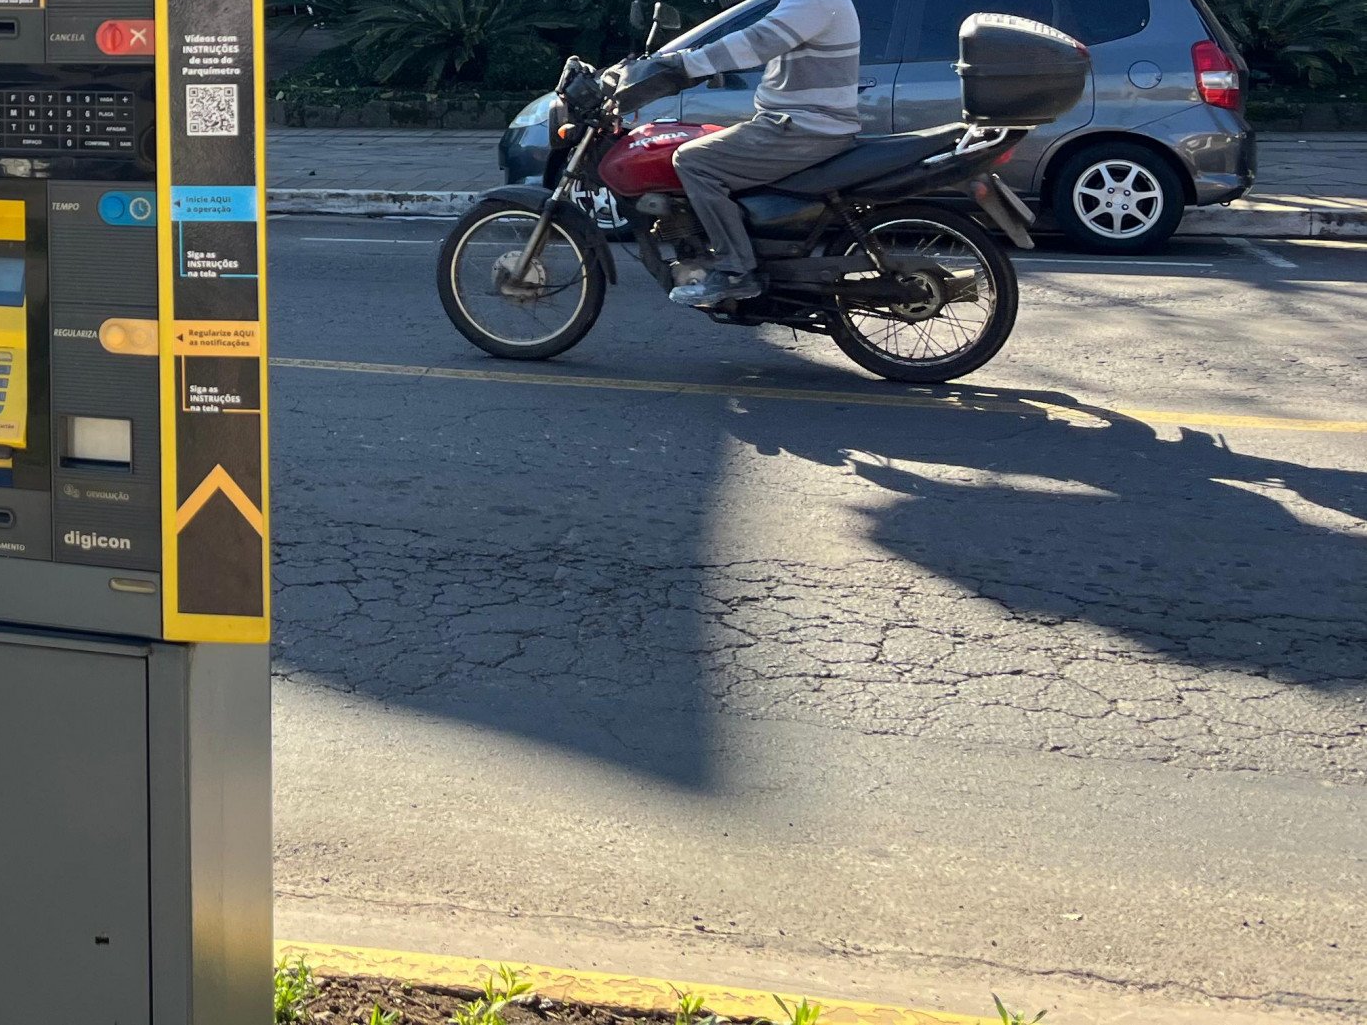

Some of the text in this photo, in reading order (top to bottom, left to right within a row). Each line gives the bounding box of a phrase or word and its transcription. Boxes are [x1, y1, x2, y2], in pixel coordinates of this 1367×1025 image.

[50, 33, 85, 42] CANCELA
[184, 34, 215, 42] Vídeos
[182, 43, 240, 55] INSTRUÇÕES
[188, 56, 201, 64] de
[220, 56, 233, 64] do
[182, 66, 241, 77] Parquímetro
[629, 131, 689, 148] HONDA
[210, 196, 231, 204] AQUI
[52, 202, 80, 211] TEMPO
[193, 205, 231, 214] operação
[187, 250, 204, 260] Siga
[187, 259, 239, 270] INSTRUÇÕES
[200, 270, 217, 278] tela
[53, 328, 98, 339] REGULARIZA
[188, 329, 255, 338] Regularize AQUI
[200, 339, 250, 348] notificações
[189, 385, 207, 394] Siga
[190, 393, 241, 404] INSTRUÇÕES
[202, 404, 219, 412] tela
[86, 490, 129, 501] DEVOLUÇÃO
[64, 530, 131, 550] digicon
